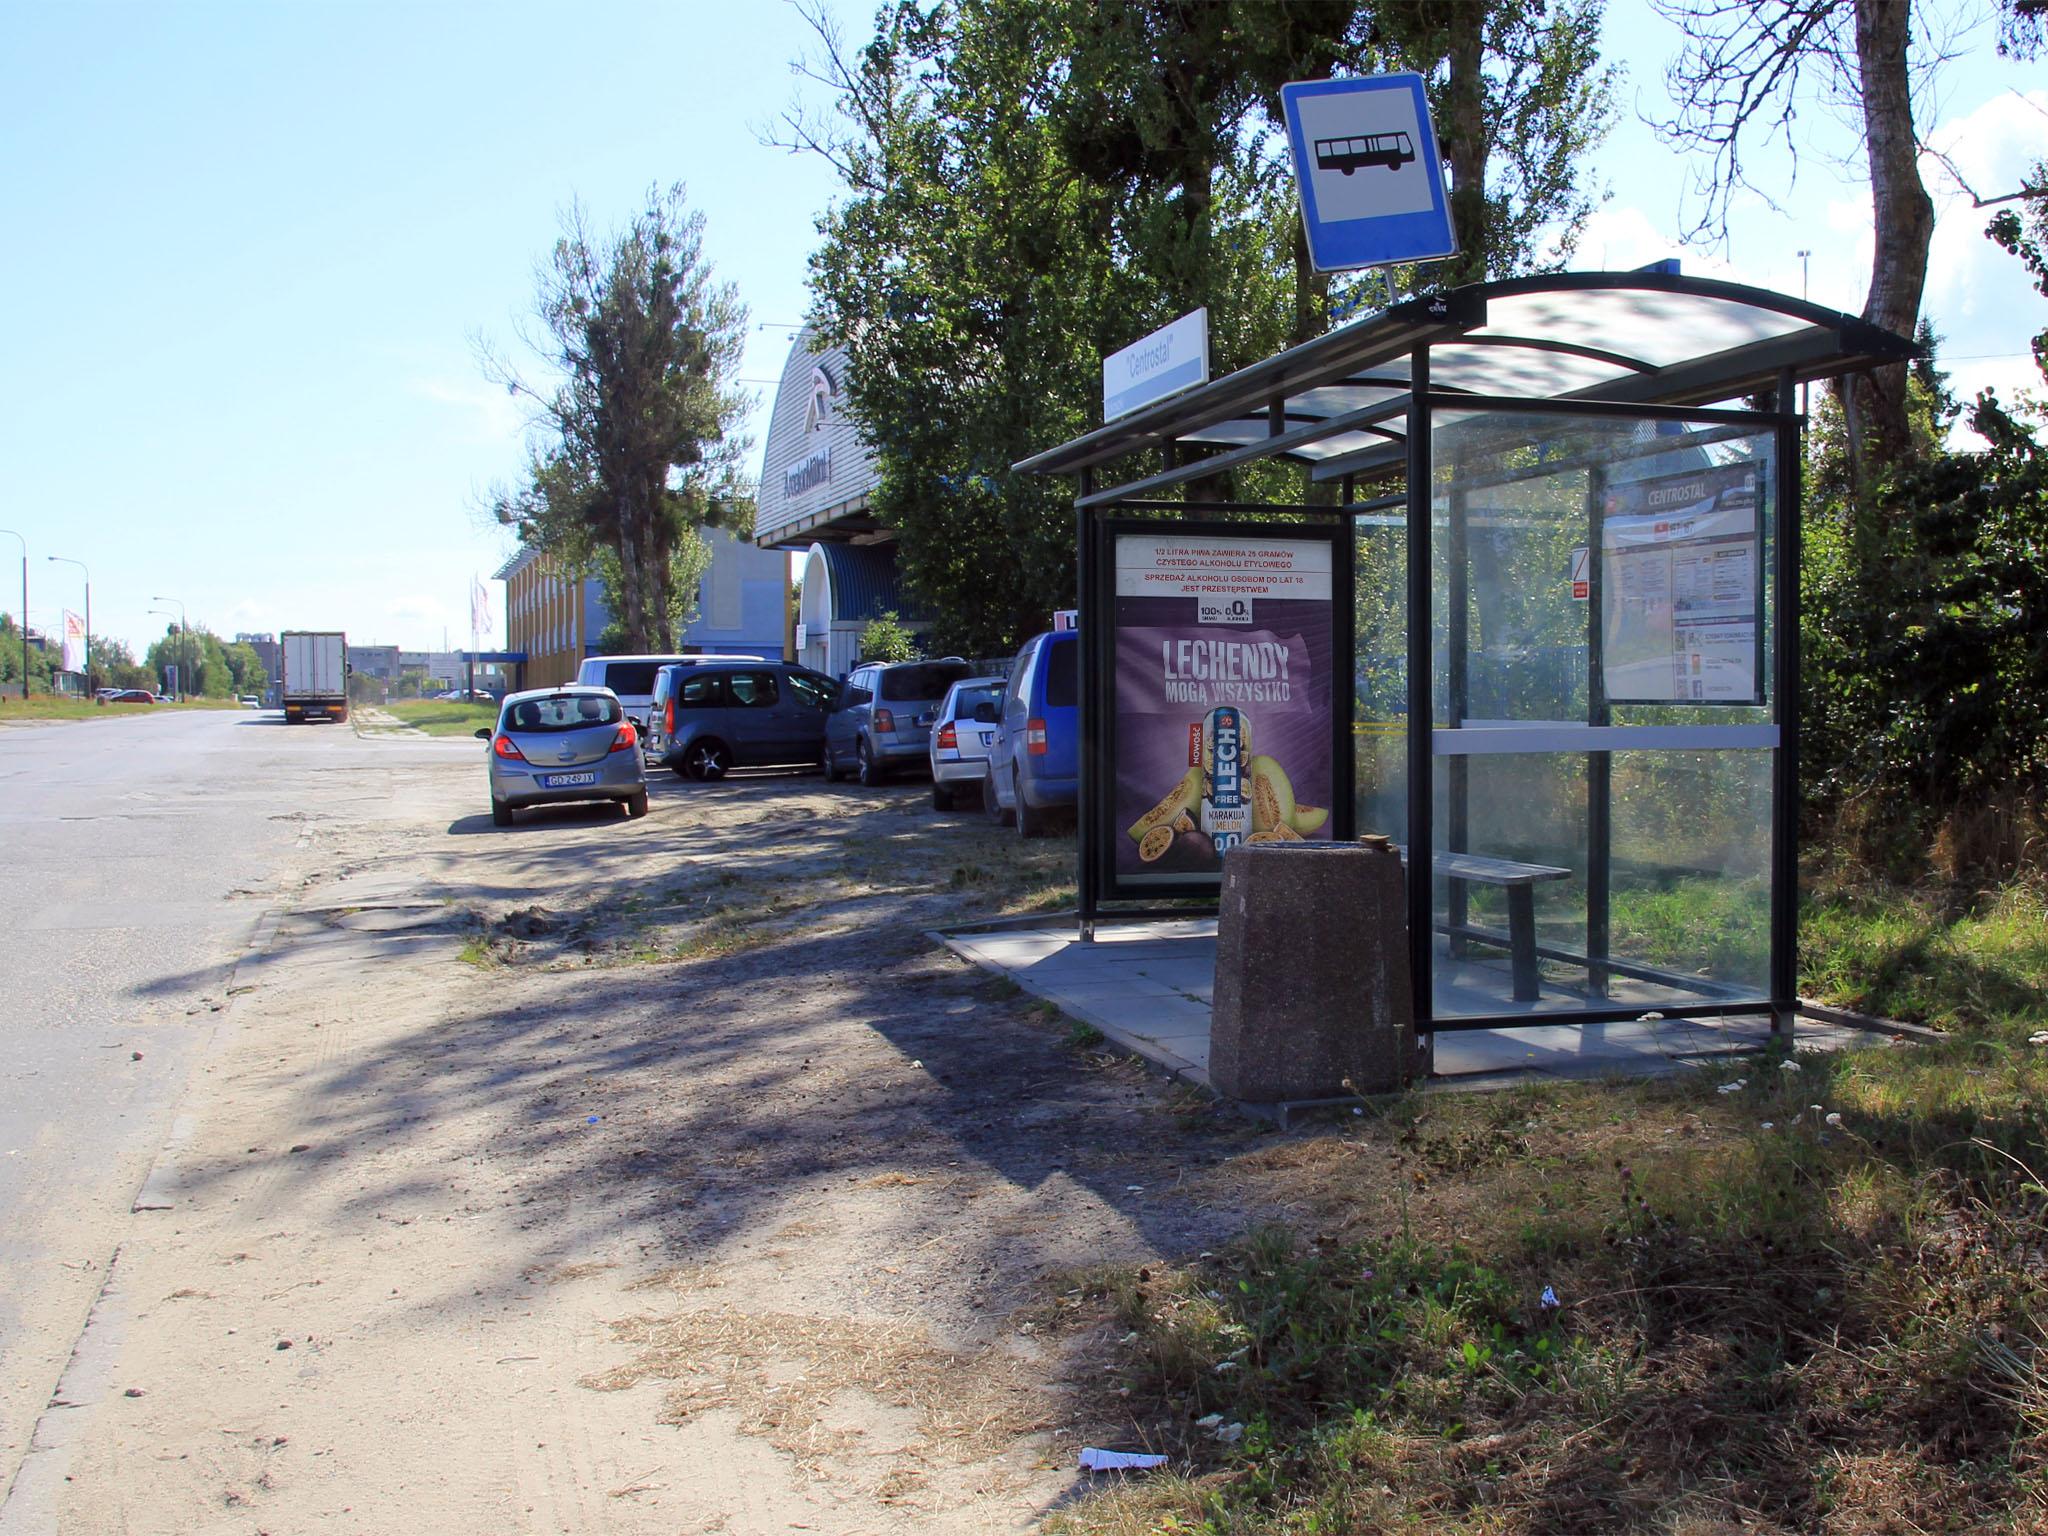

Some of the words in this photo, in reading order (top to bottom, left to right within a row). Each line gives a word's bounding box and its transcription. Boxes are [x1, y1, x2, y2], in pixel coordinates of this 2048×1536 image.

[1648, 483, 1706, 505] CENTROSTAL
[1258, 550, 1294, 559] GRAMÓW
[1144, 573, 1185, 582] SPRZEDAŻ
[1187, 575, 1228, 583] ALKOHOLU
[1202, 586, 1269, 594] PRZESTĘPSTWEM
[1162, 640, 1289, 680] LECHENDY
[1165, 681, 1208, 706] MOGĄ
[1212, 682, 1291, 702] WSZYSTKO
[1192, 727, 1201, 764] NOWOŚĆ
[1217, 728, 1238, 791] LECH
[550, 776, 564, 785] GD
[1214, 795, 1239, 804] FREE
[1208, 810, 1246, 820] MARAKUJA
[1216, 820, 1242, 831] MELON
